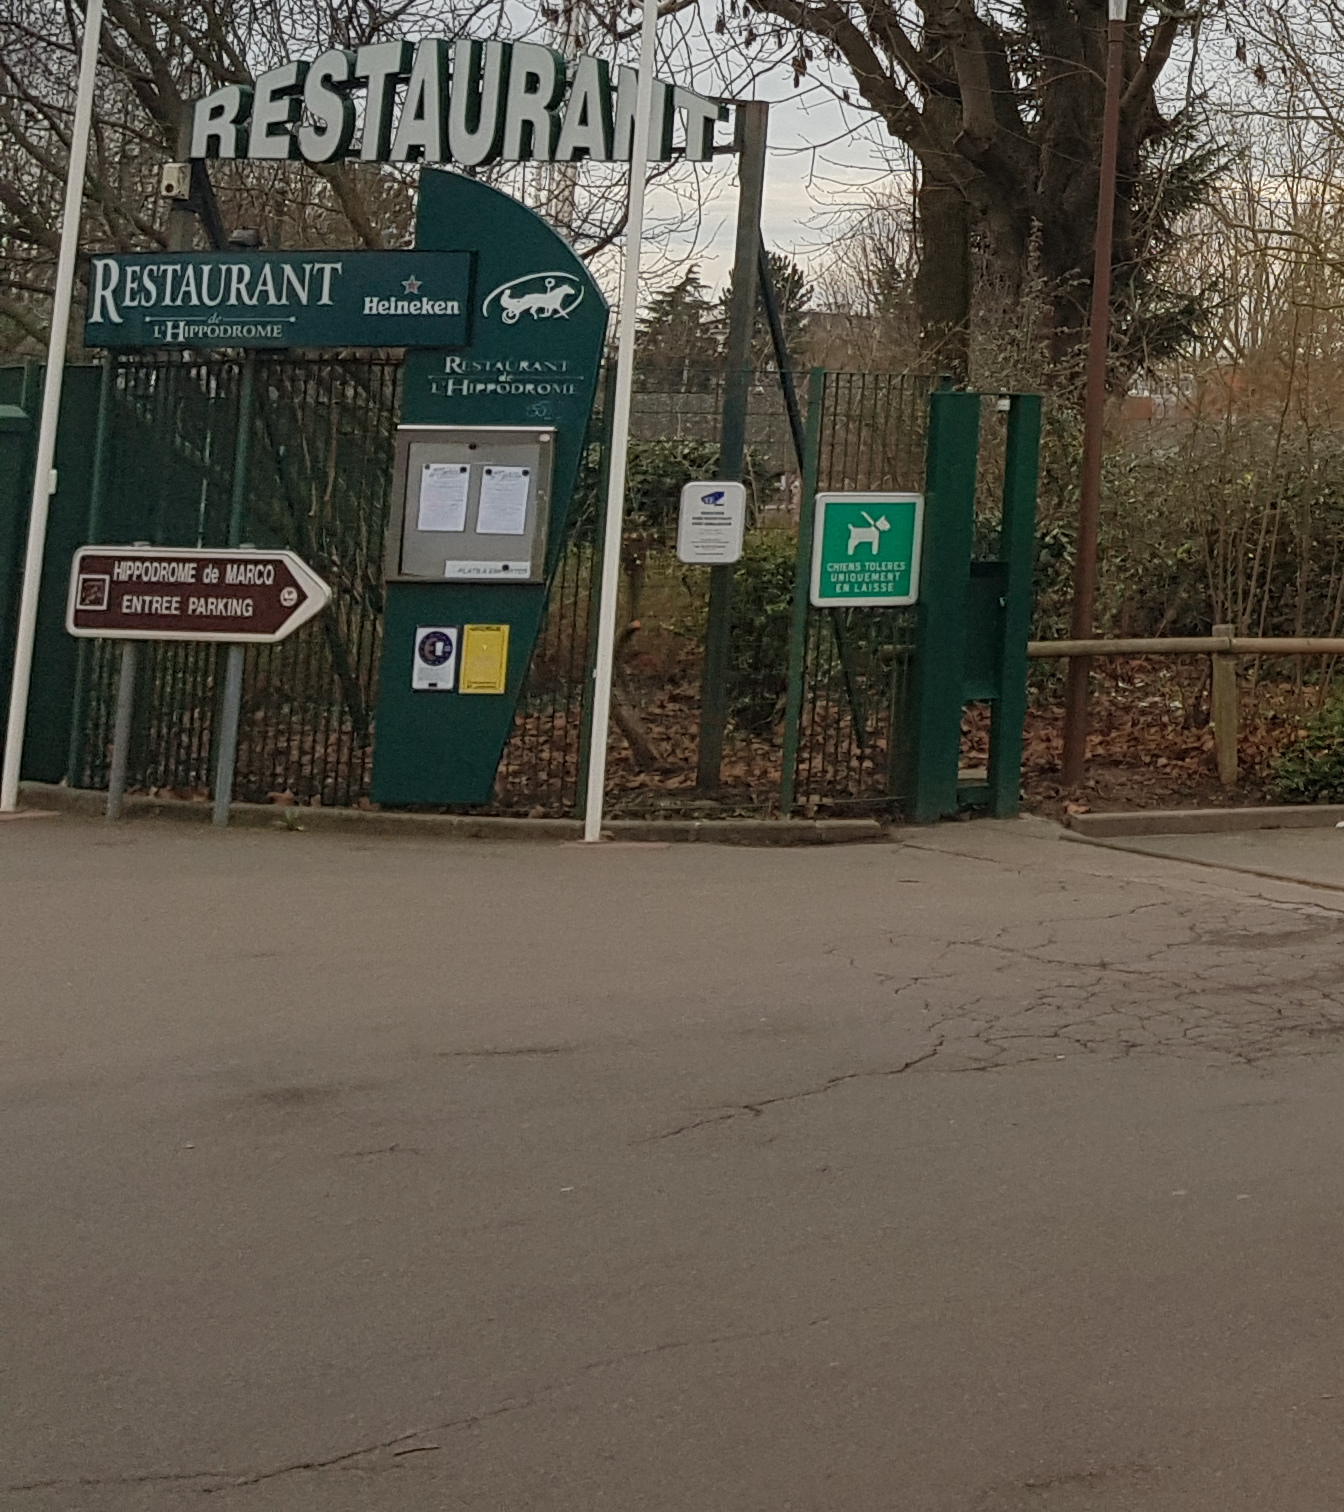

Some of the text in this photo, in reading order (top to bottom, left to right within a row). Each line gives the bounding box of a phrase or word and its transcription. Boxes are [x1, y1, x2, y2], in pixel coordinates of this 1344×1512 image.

[190, 38, 728, 167] RESTAURANT
[88, 258, 343, 324] RESTAURANT
[363, 296, 460, 316] Heineken
[206, 311, 223, 324] de
[153, 320, 283, 343] L'HIPPODROME
[444, 356, 567, 374] RESTAURANT
[113, 560, 275, 586] HIPPODROME de MARCQ
[826, 561, 906, 572] CHIENS TOLERES
[830, 572, 901, 582] UNIQUEMENT
[835, 583, 895, 593] EN LAISSE
[121, 594, 254, 617] ENTREE PARKING
